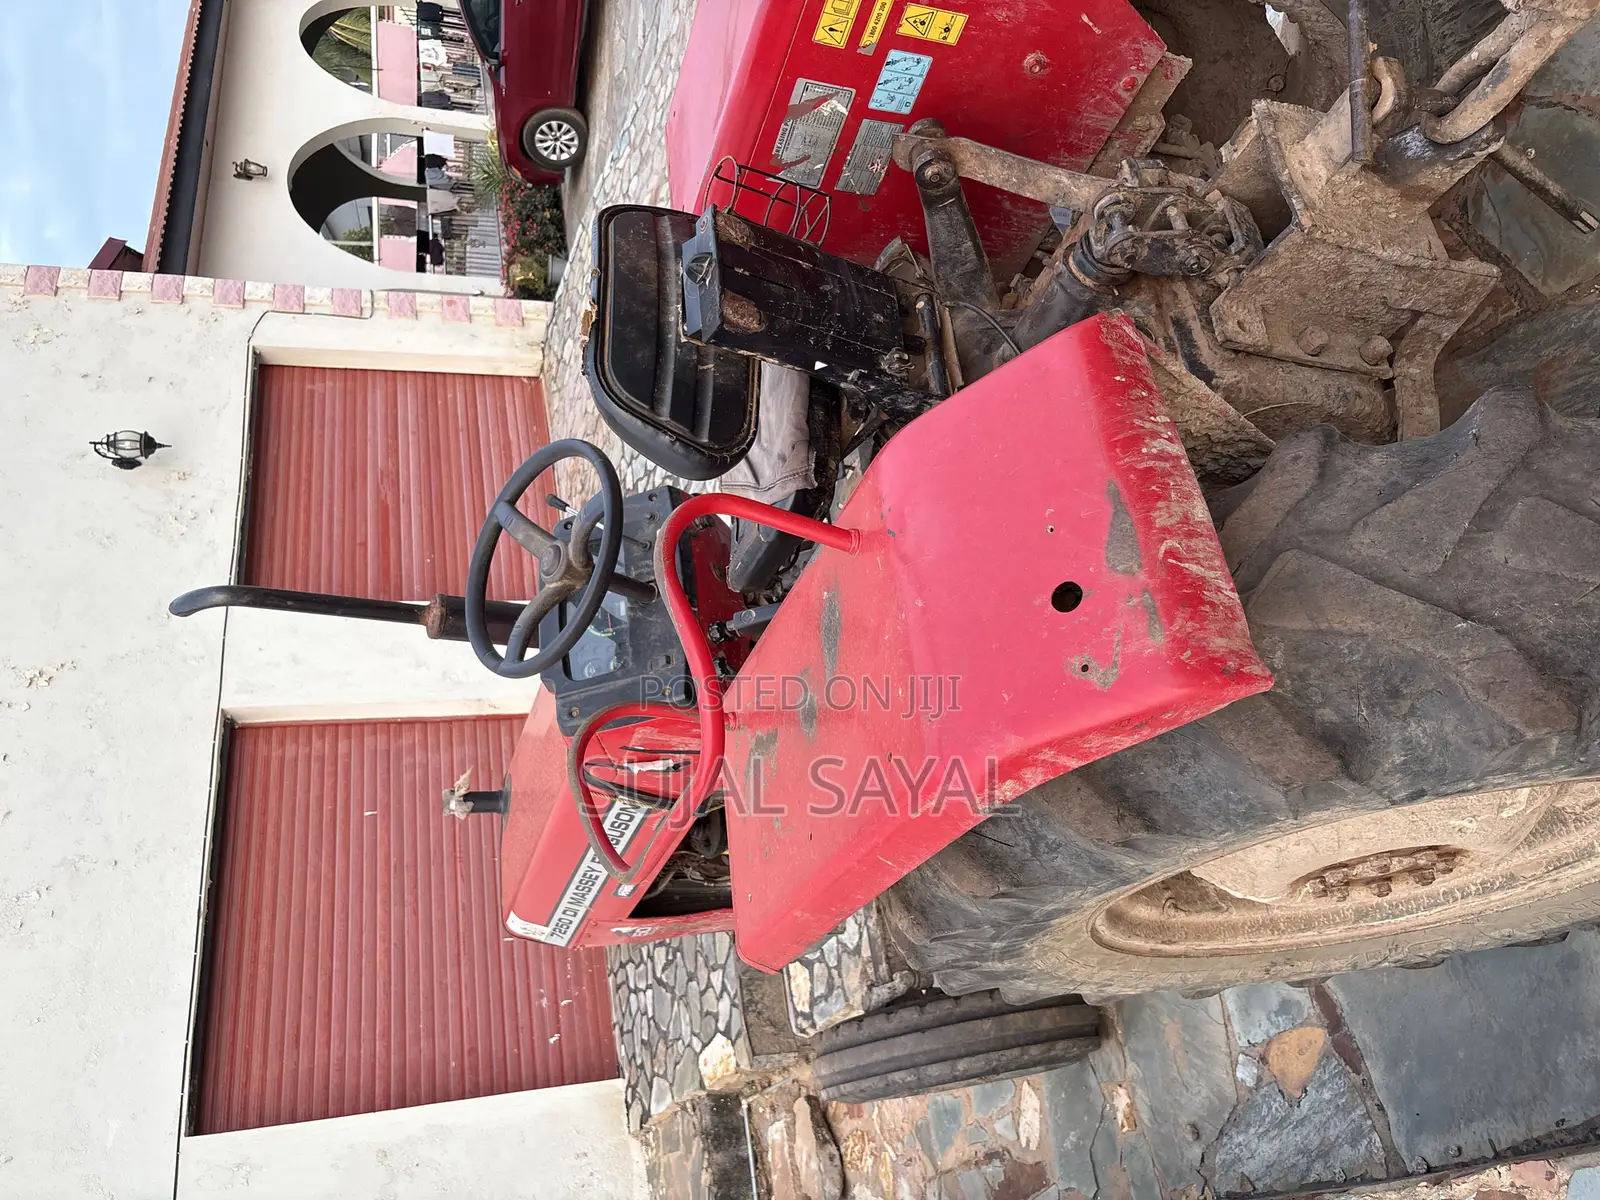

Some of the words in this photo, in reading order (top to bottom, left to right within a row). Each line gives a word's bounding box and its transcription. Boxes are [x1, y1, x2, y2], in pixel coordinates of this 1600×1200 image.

[868, 25, 877, 38] 1800
[874, 12, 882, 25] 4200
[879, 1, 887, 11] 200
[566, 865, 602, 907] MASSEY
[562, 906, 580, 918] DI
[550, 918, 574, 939] 7250
